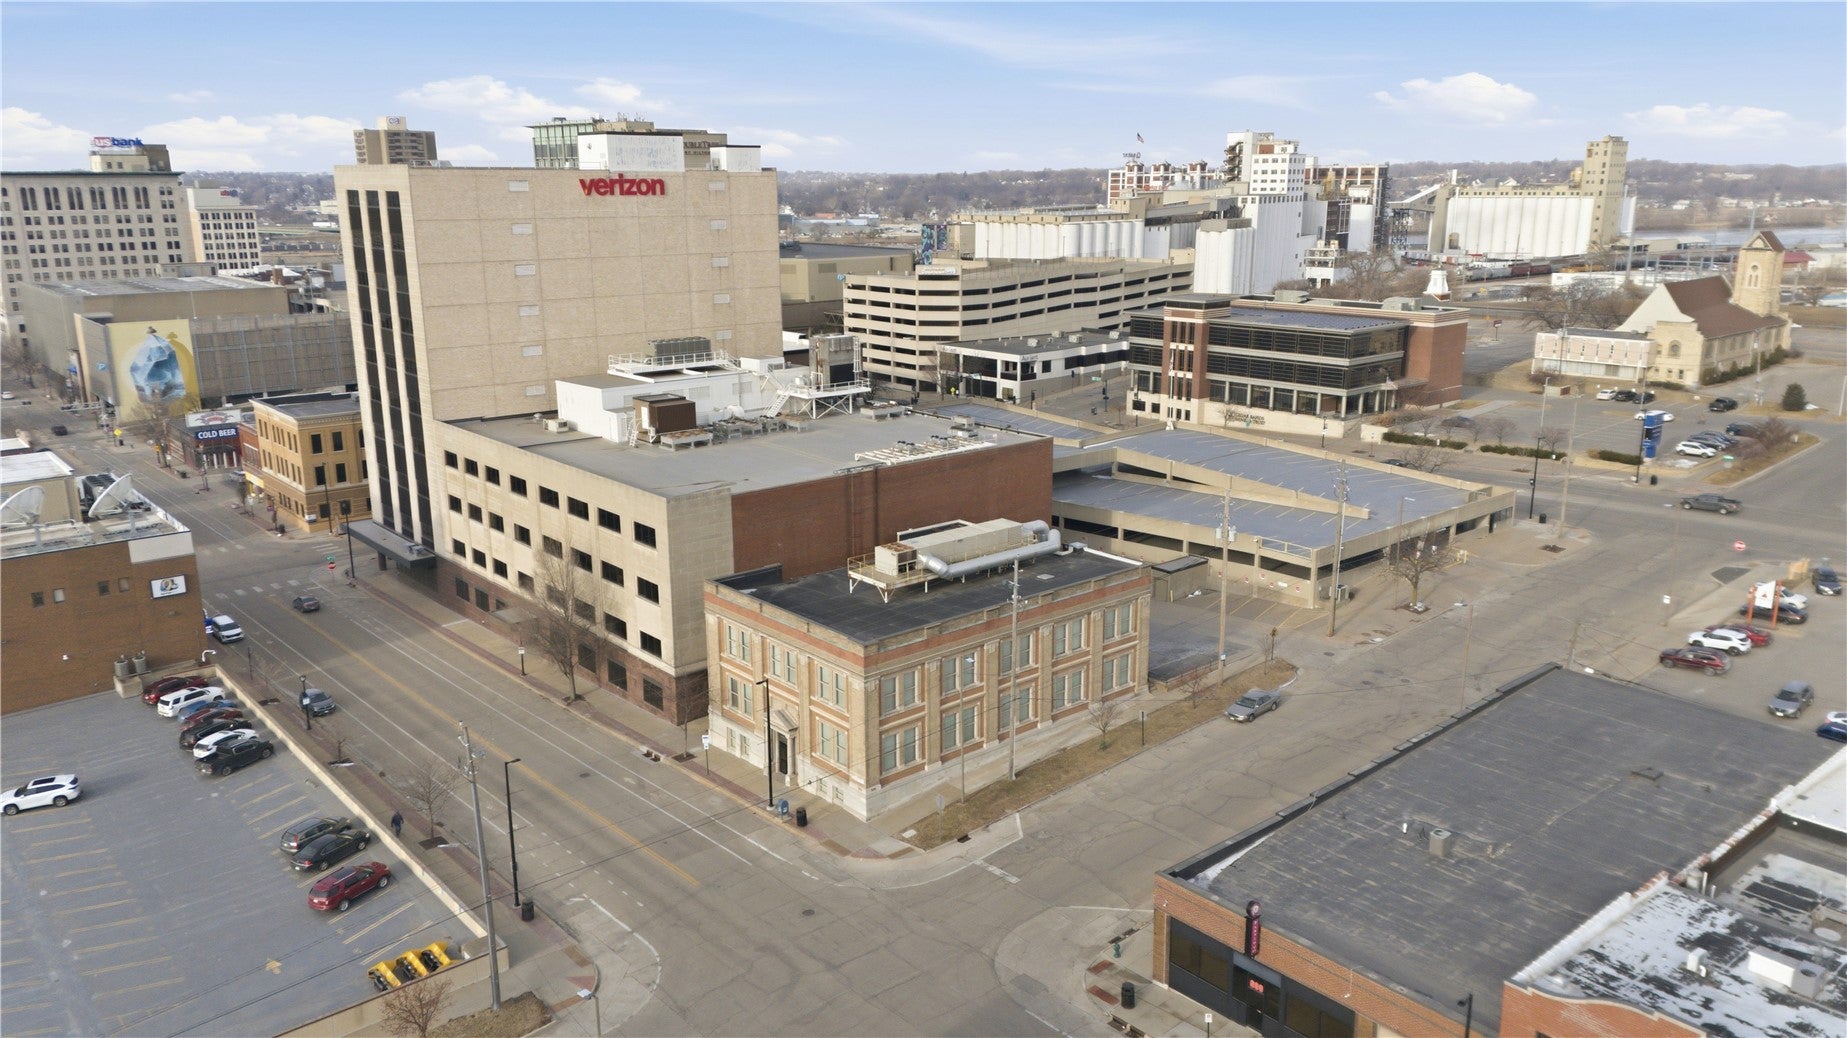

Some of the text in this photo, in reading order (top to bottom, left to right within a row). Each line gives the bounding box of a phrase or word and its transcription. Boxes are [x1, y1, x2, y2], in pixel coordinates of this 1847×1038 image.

[578, 173, 666, 197] verizon
[198, 428, 236, 439] COLD BEER
